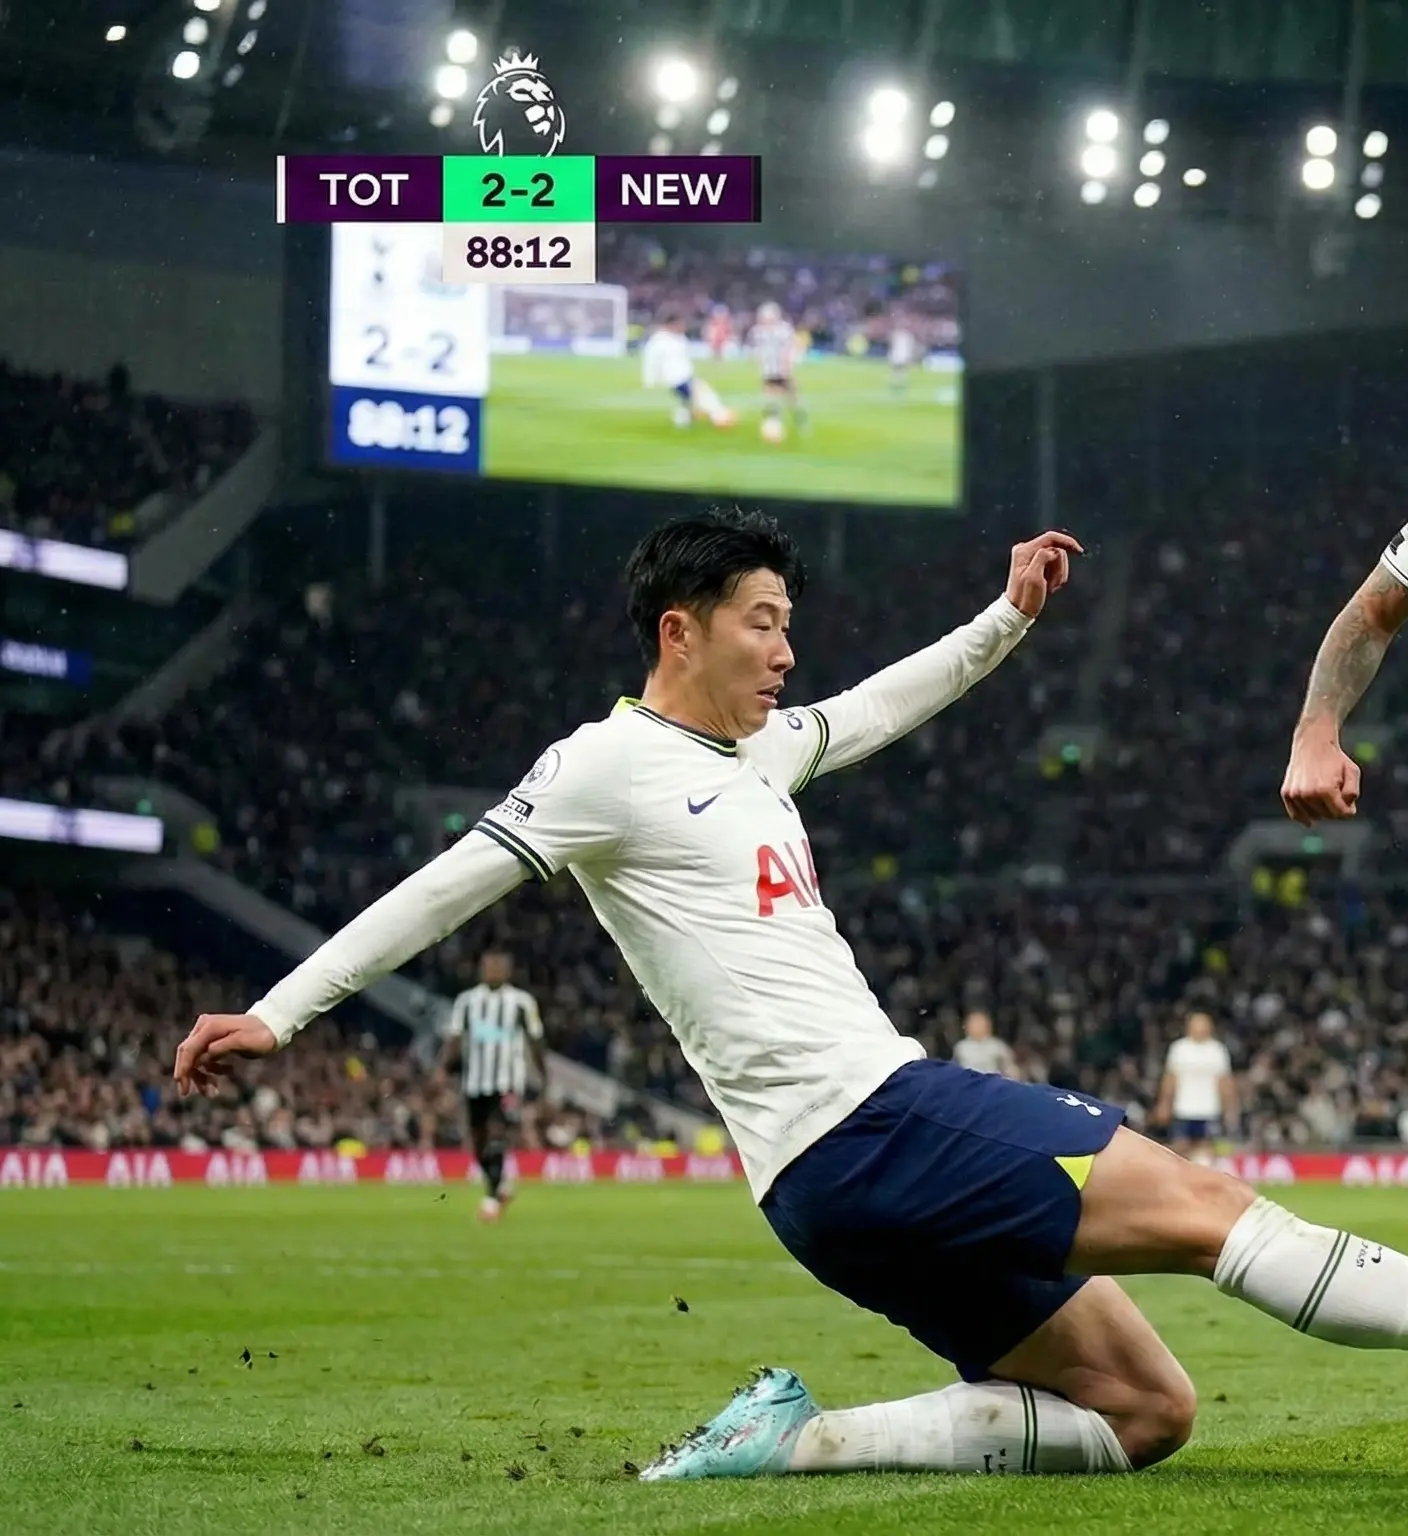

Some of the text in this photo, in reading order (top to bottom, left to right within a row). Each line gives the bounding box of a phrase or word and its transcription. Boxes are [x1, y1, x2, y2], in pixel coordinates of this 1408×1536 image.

[0, 1152, 69, 1190] AIA
[106, 1152, 173, 1190] AIA
[206, 1151, 268, 1189] AIA
